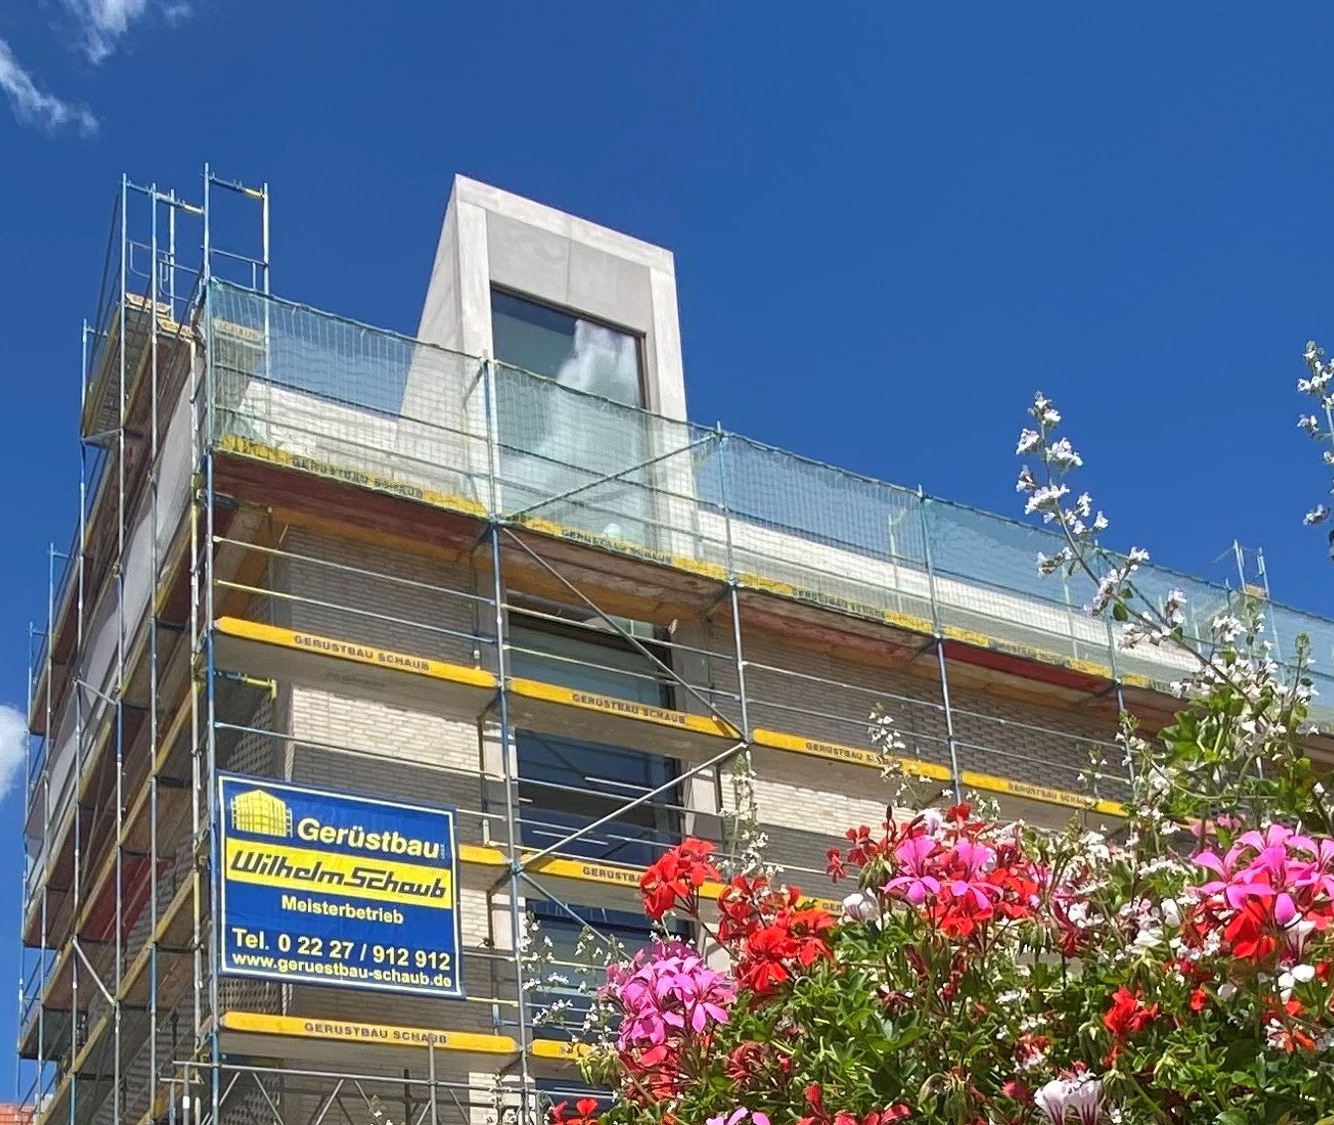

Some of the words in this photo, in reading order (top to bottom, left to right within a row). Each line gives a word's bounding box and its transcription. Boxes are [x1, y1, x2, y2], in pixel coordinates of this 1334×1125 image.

[378, 652, 430, 672] SCHAUB
[297, 817, 440, 859] Gerüstbau
[230, 850, 345, 886] Wilhelm
[344, 866, 447, 899] Schaub
[281, 894, 404, 924] Meisterbetrieb
[231, 927, 270, 950] Tel.
[278, 933, 291, 952] 0
[297, 936, 323, 956] 22
[329, 940, 354, 959] 27
[359, 943, 367, 962] /
[373, 944, 410, 967] 912
[415, 950, 451, 971] 912
[231, 953, 452, 988] www.geruestbau-schaub.de
